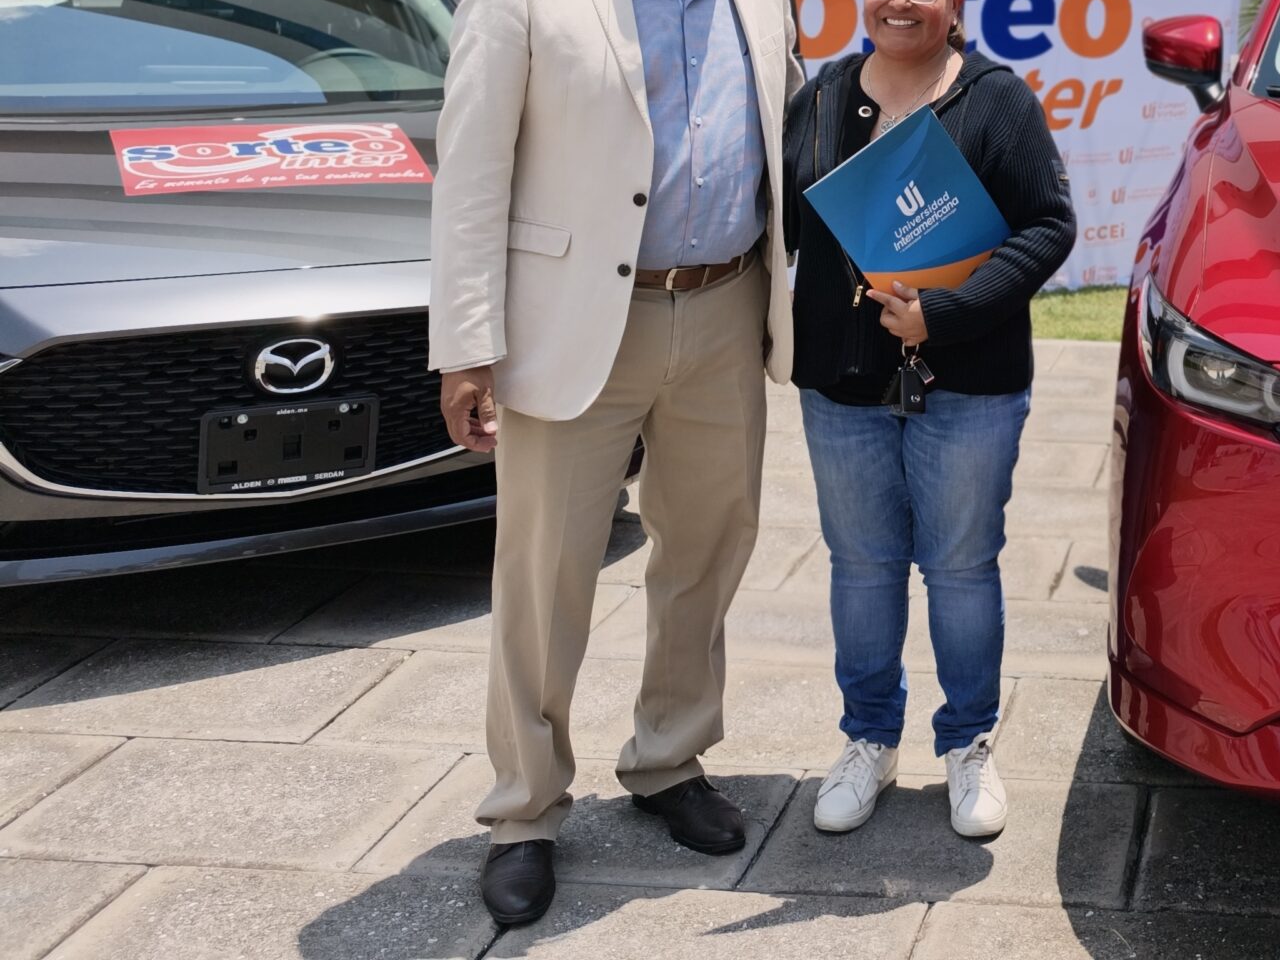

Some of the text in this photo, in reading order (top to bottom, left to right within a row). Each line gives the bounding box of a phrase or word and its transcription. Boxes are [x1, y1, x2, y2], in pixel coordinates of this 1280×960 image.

[1024, 68, 1124, 131] ter
[123, 137, 405, 163] sorteo
[280, 153, 408, 169] inter
[135, 179, 158, 190] Es
[893, 196, 960, 252] Interamericana
[894, 191, 950, 238] Universidad
[1083, 222, 1125, 241] CCEi
[231, 480, 262, 490] ALDEN
